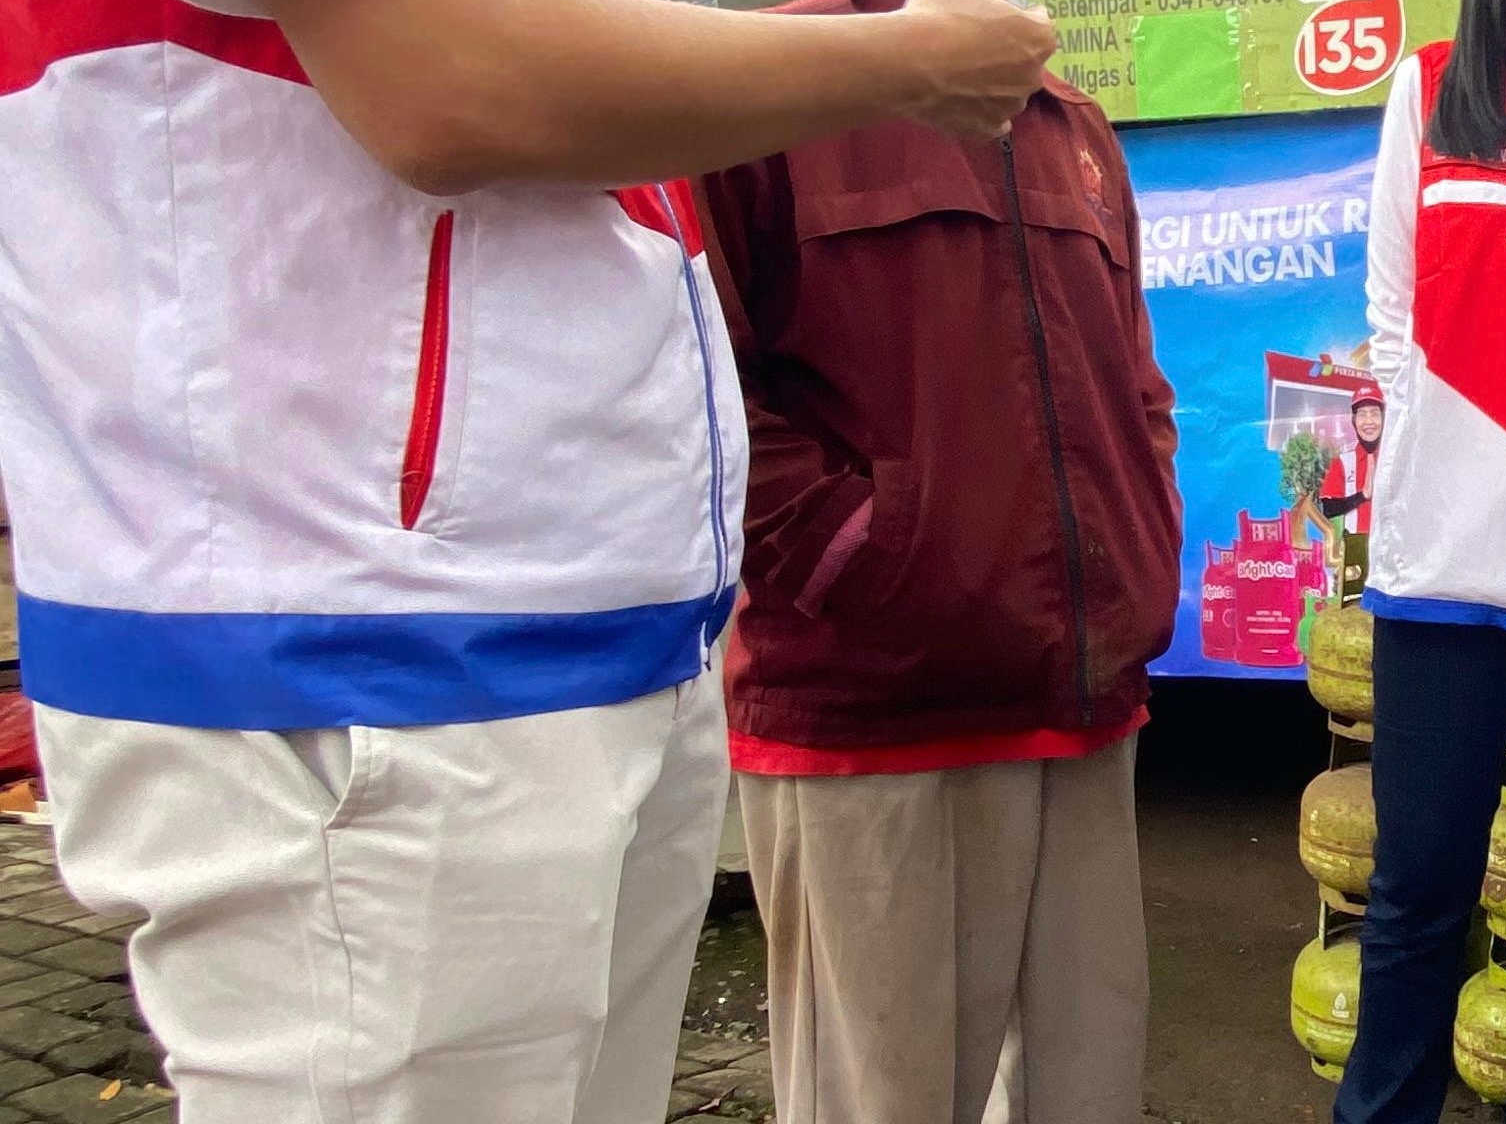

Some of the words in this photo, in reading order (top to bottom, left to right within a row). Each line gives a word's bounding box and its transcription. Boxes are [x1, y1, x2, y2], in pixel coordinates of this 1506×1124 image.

[1055, 25, 1120, 54] AMINA
[1303, 16, 1388, 75] 135
[1063, 63, 1121, 94] Migas
[1141, 214, 1191, 251] RGI
[1201, 200, 1333, 246] UNTUK
[1343, 196, 1370, 234] R
[1141, 241, 1337, 290] ENANGAN
